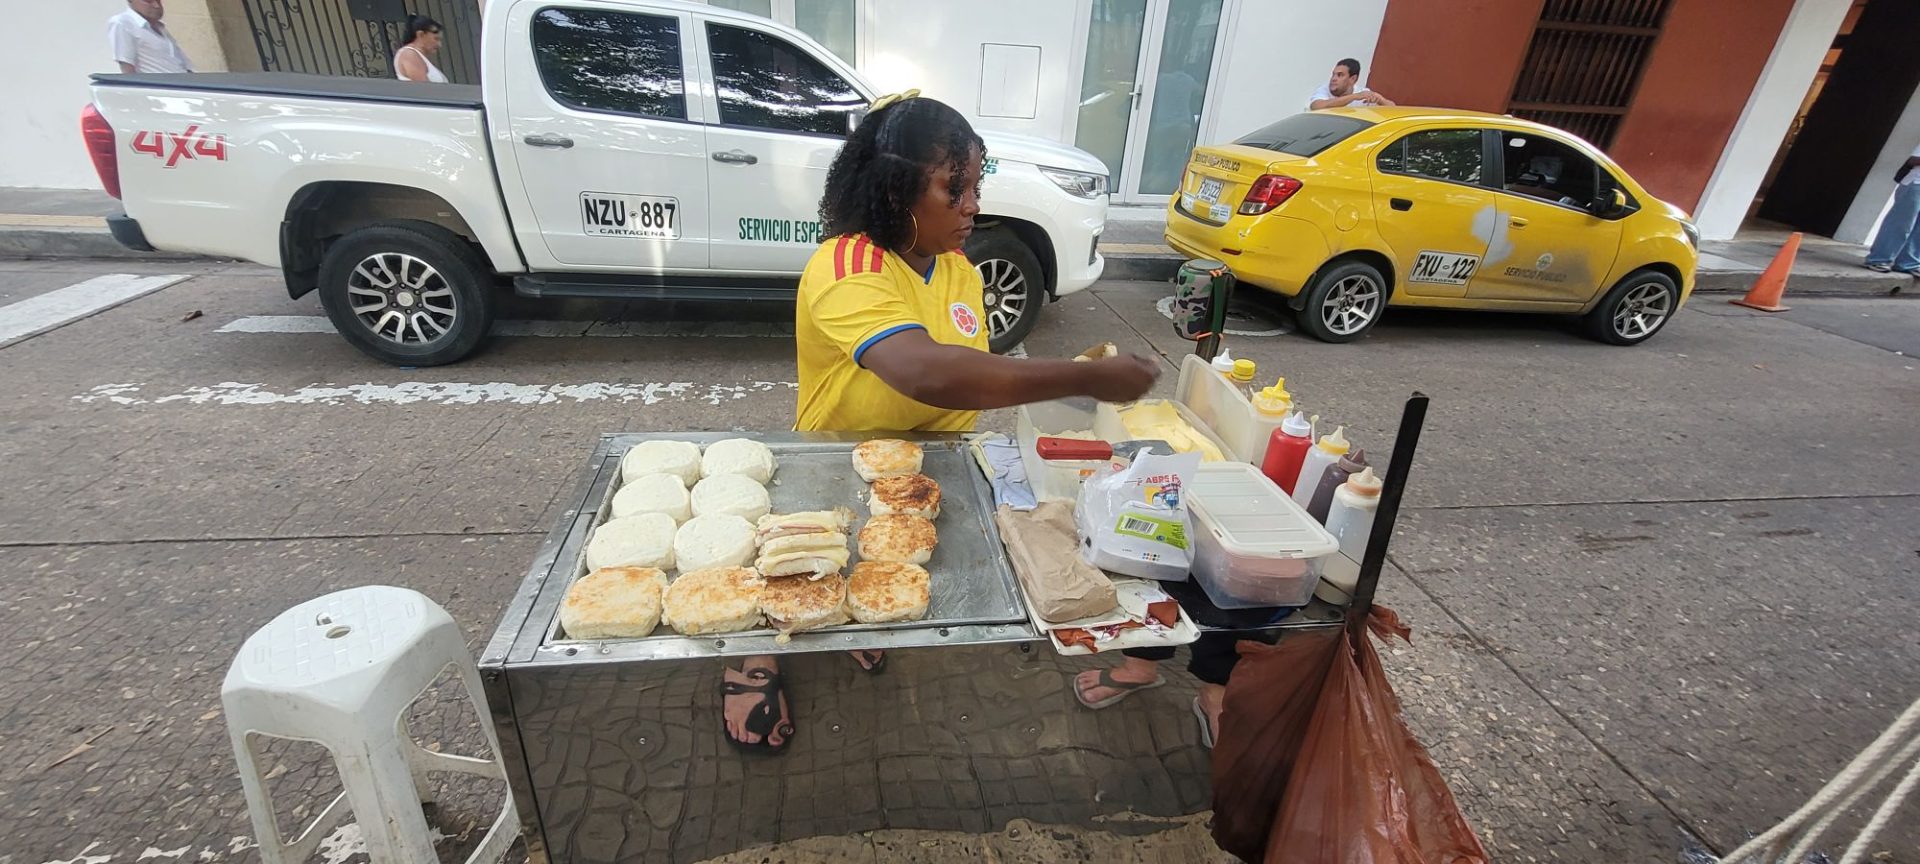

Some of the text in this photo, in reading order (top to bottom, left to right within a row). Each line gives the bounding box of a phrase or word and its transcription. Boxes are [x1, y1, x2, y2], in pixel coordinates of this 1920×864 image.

[584, 198, 676, 229] NZU 887
[599, 228, 666, 237] CARTAGENA
[739, 217, 823, 244] SERVICIO ESPE
[1412, 254, 1476, 280] FXU 122
